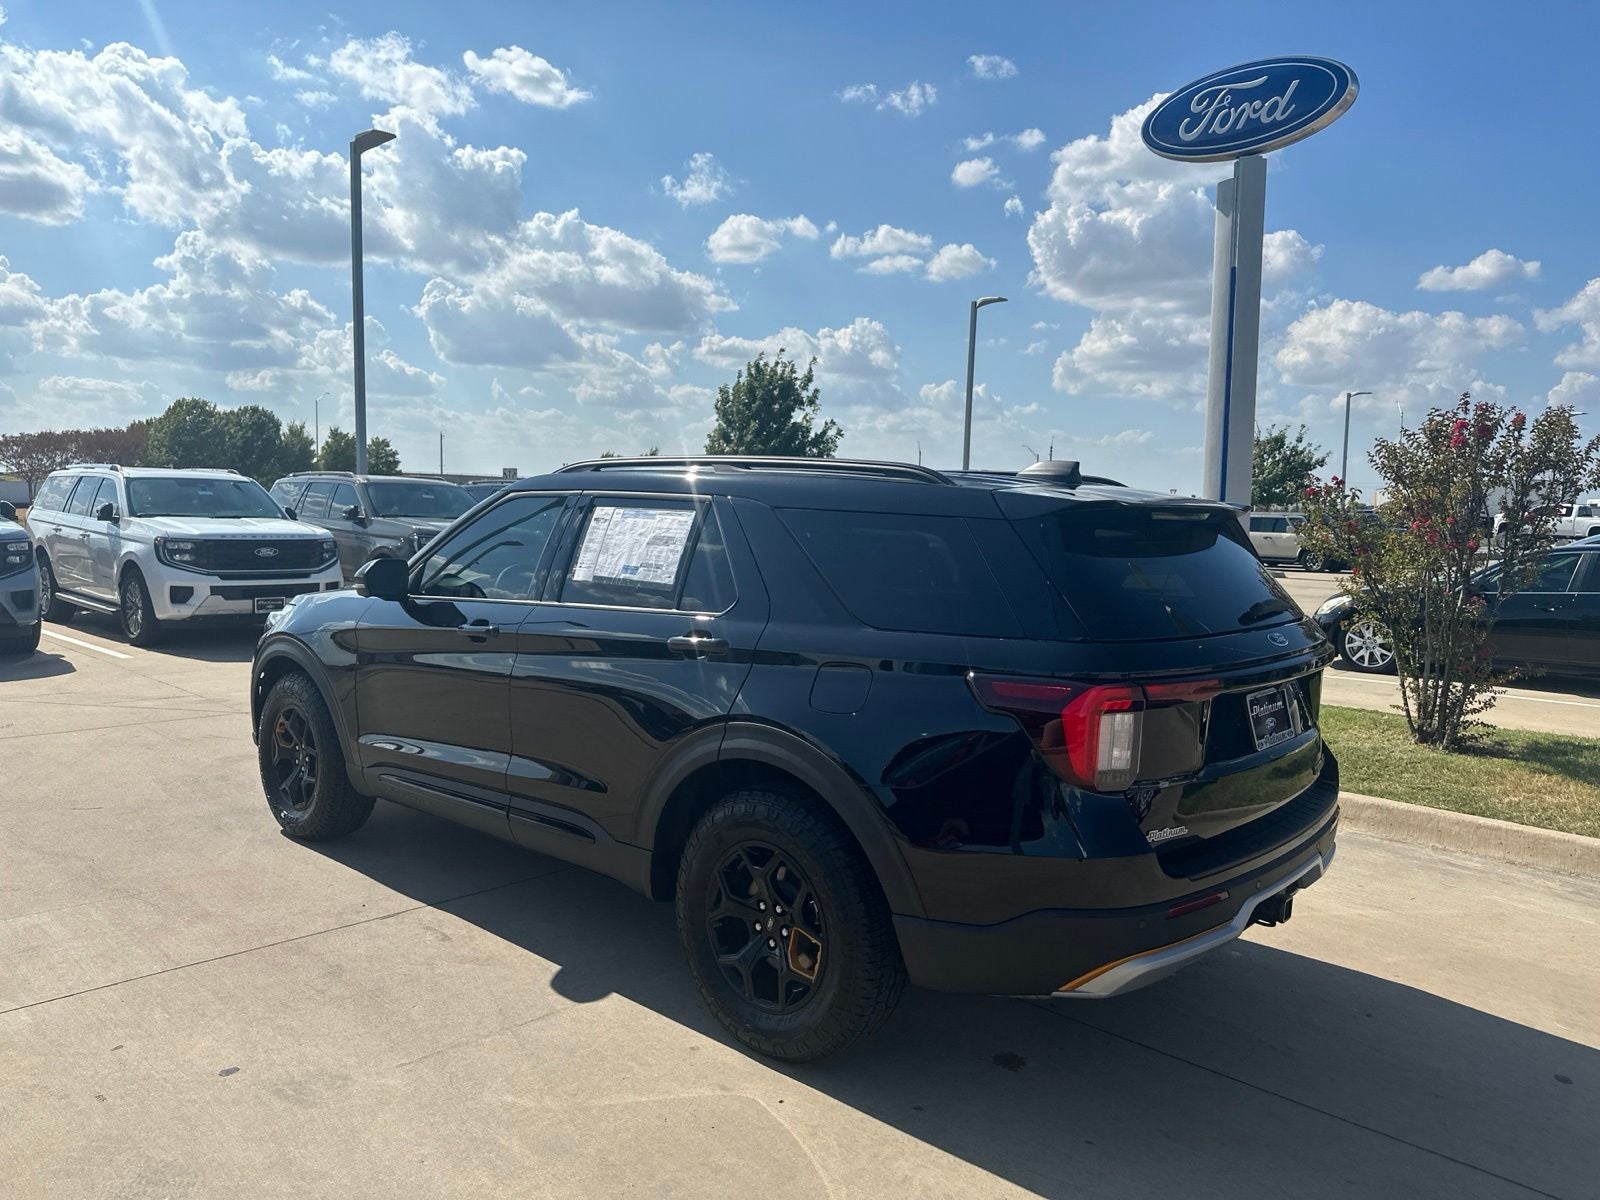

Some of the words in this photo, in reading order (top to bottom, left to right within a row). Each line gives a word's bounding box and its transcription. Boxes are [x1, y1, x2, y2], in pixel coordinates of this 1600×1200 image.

[1179, 76, 1300, 141] Ford
[1251, 701, 1285, 718] Platinum
[1146, 825, 1189, 842] Platinum
